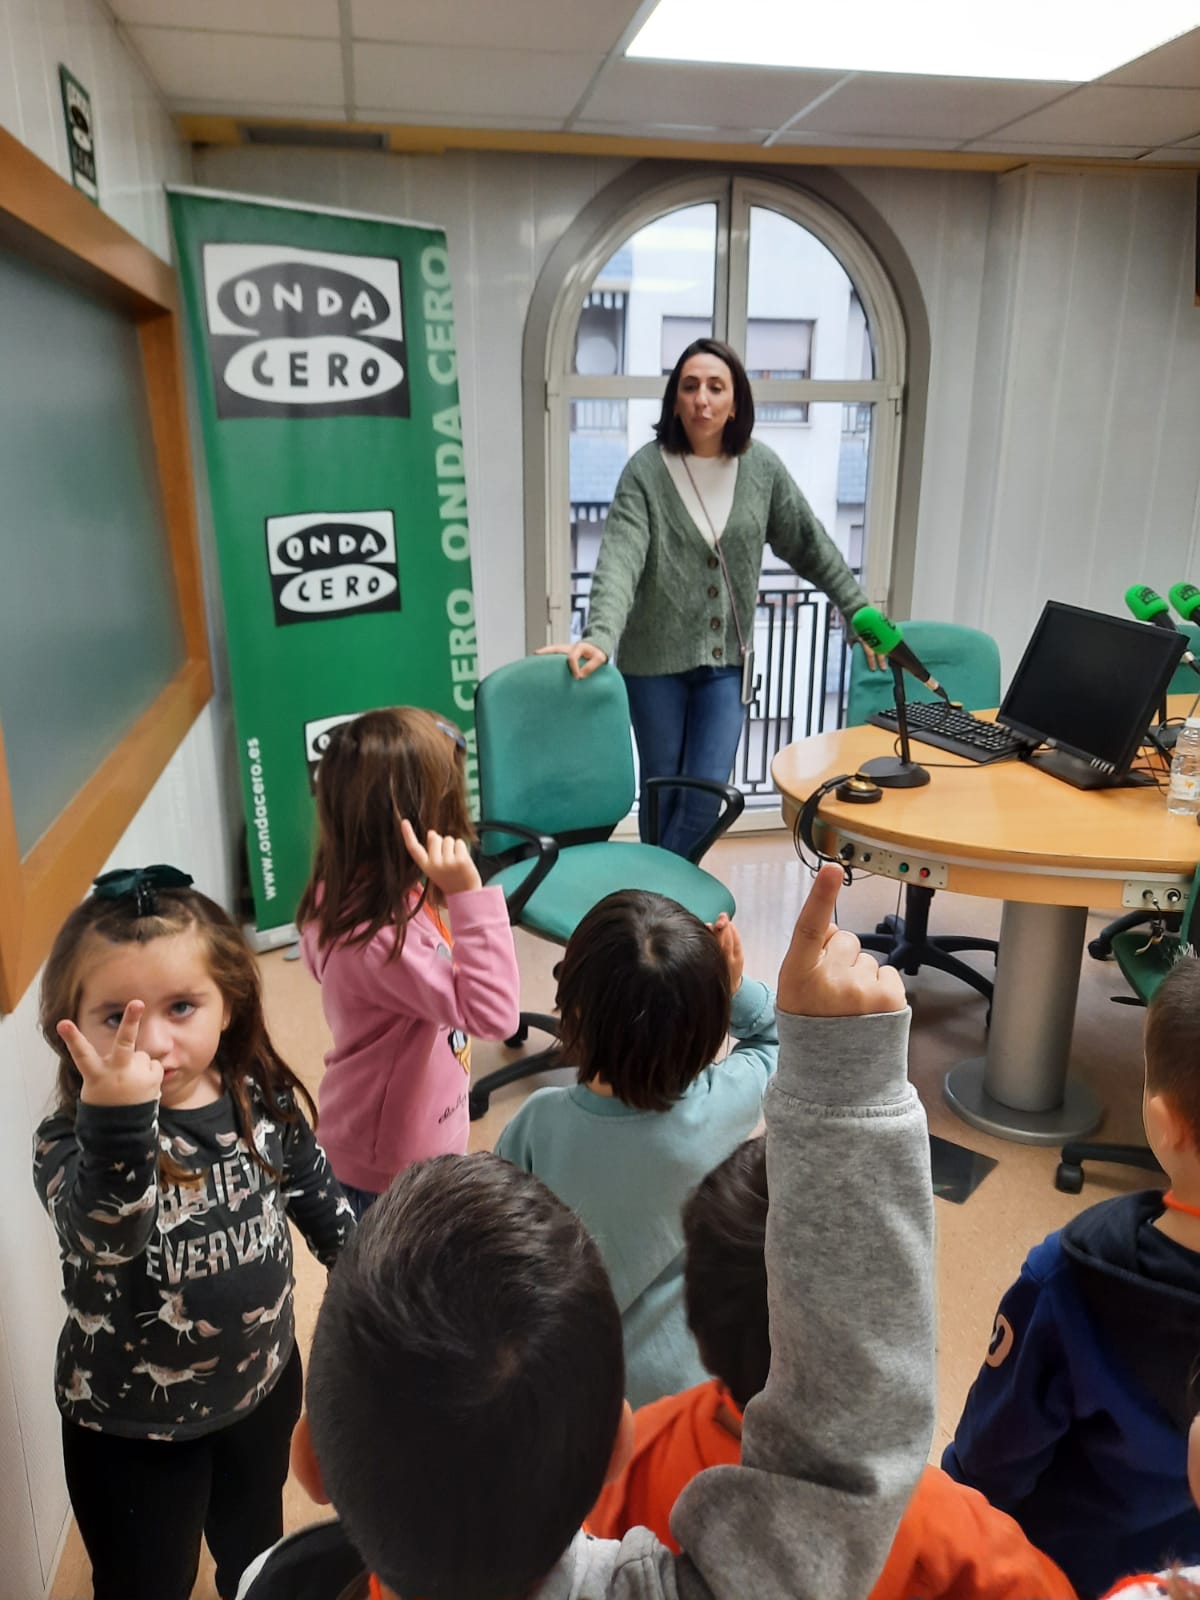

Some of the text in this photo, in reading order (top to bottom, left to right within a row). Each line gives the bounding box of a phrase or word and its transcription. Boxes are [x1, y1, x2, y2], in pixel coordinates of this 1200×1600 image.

[234, 279, 377, 321] ONDA
[420, 245, 458, 386] CERO
[252, 350, 380, 387] CERO
[432, 403, 470, 561] ONDA
[286, 532, 379, 561] ONDA
[298, 576, 380, 602] CERO
[446, 588, 478, 712] CERO
[247, 737, 276, 900] www.ondacero.es
